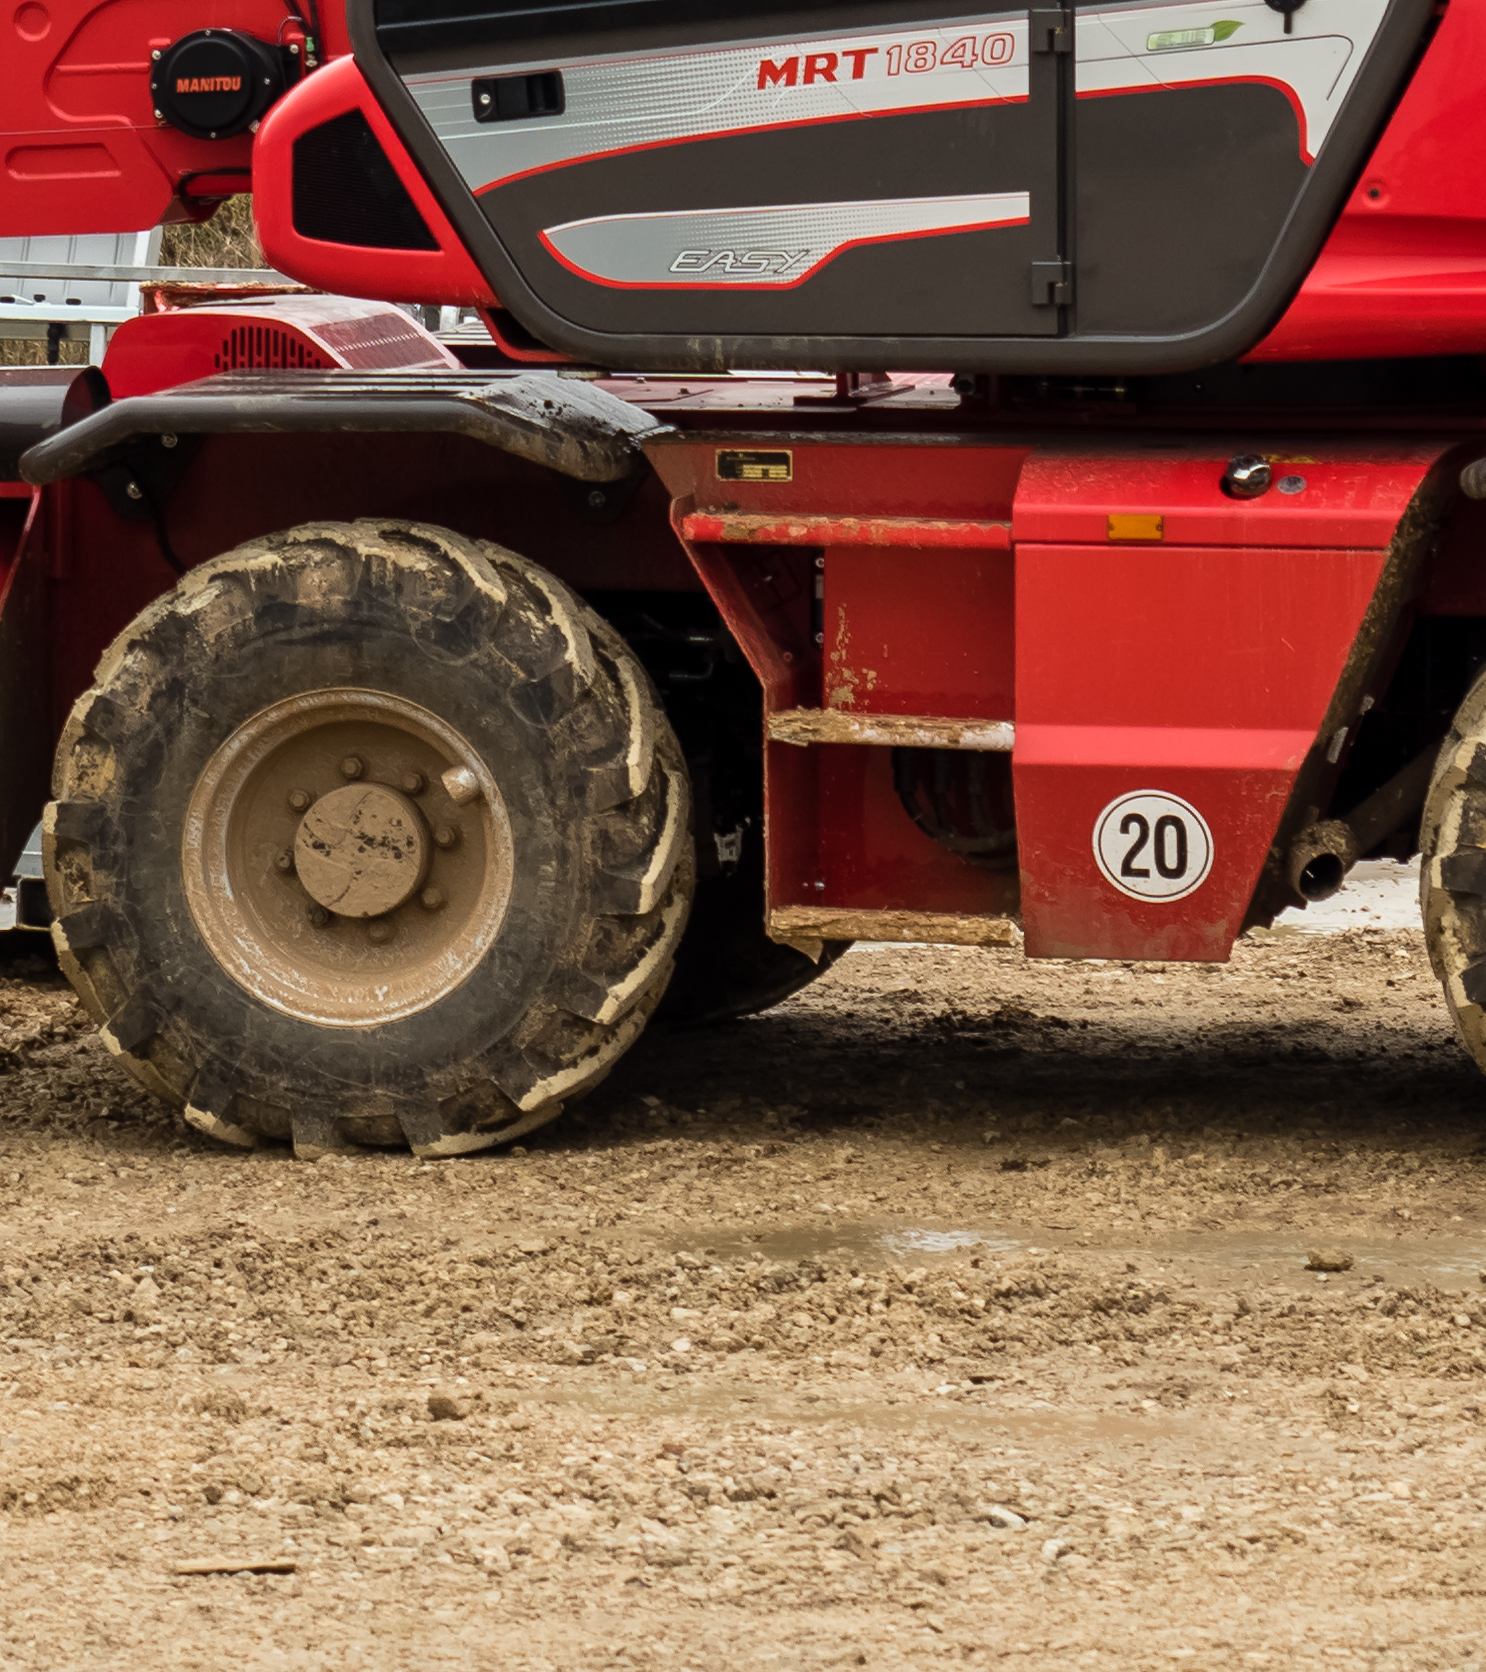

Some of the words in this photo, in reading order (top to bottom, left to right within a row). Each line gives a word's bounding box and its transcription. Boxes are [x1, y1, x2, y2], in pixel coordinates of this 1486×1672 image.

[757, 47, 879, 90] MRT
[886, 32, 1015, 76] 1840
[176, 76, 241, 93] MANITOU
[669, 249, 810, 274] EASY
[1120, 813, 1188, 879] 20
